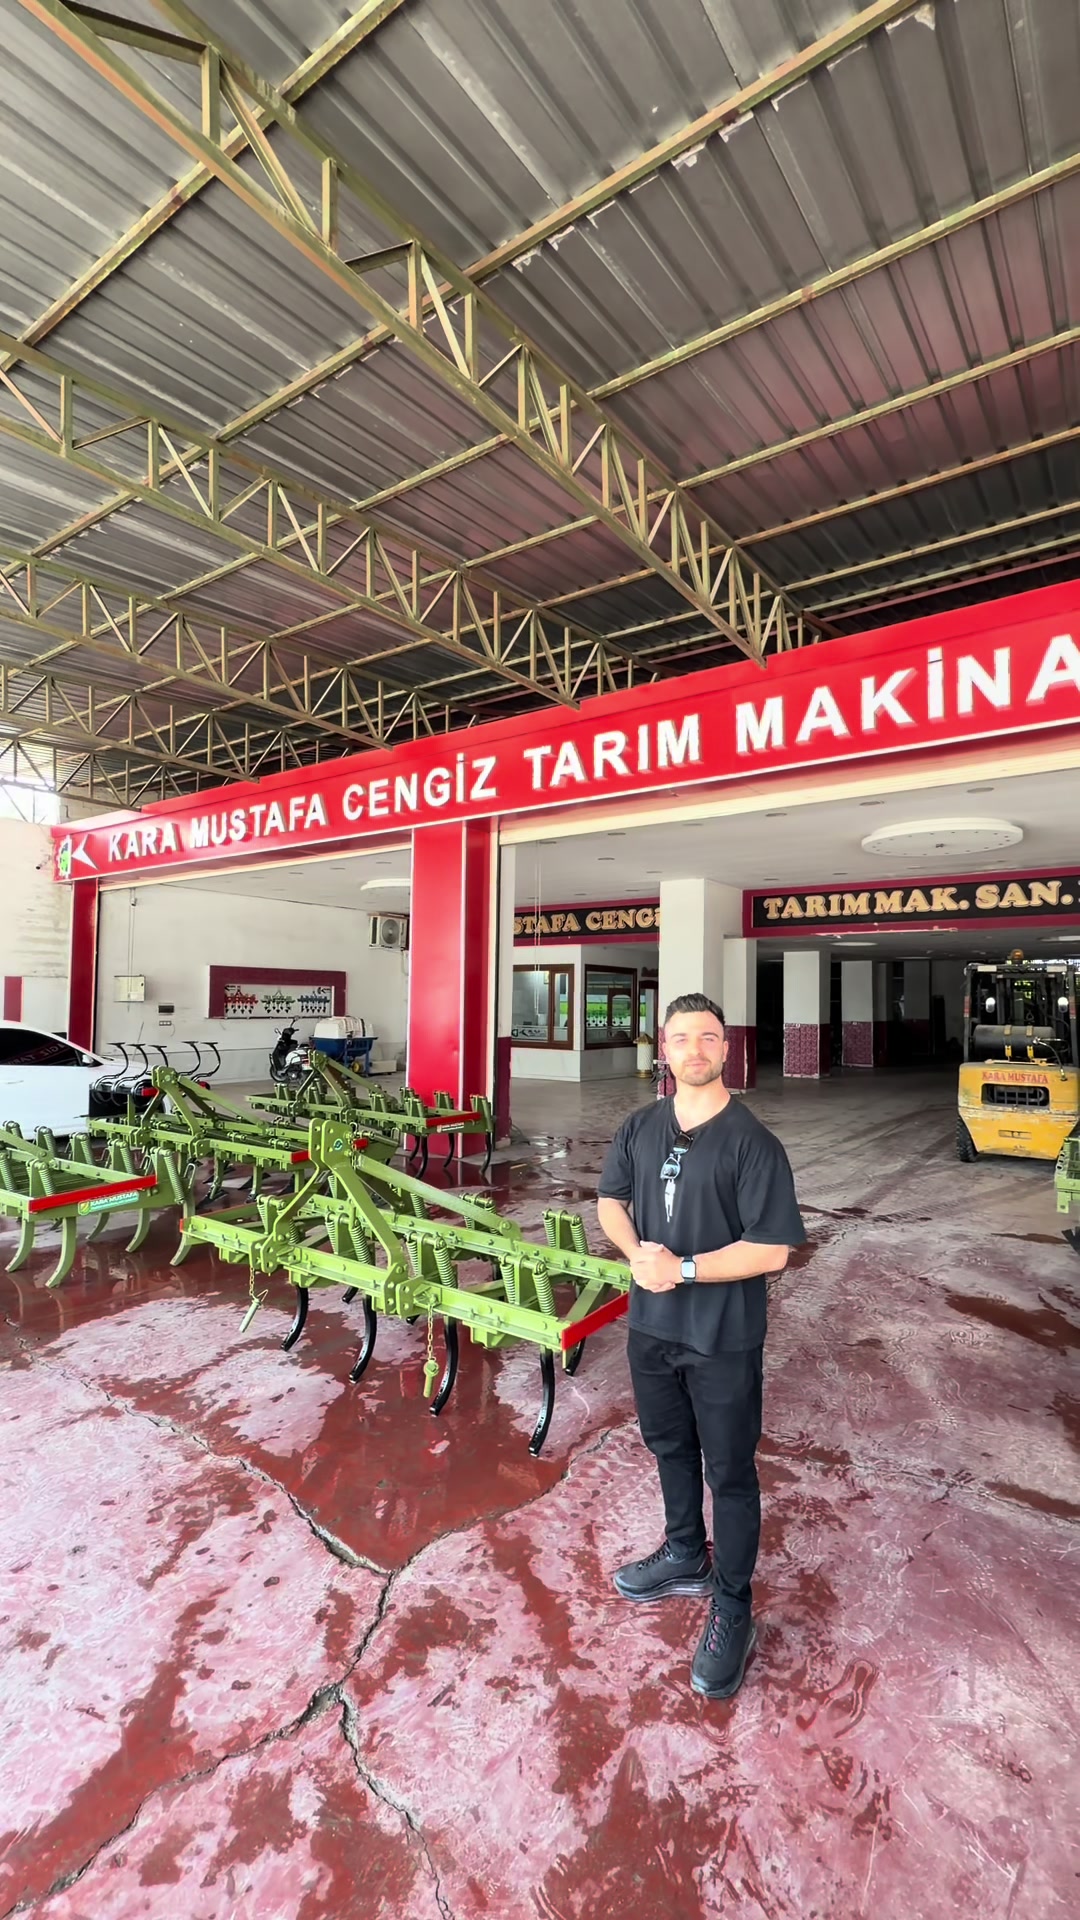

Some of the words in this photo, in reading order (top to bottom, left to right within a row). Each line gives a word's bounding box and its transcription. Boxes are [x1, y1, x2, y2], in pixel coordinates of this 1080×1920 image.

[108, 822, 179, 862] KARA
[189, 793, 328, 849] MUSTAFA
[342, 752, 497, 821] CENGİZ
[523, 713, 701, 791] TARIM
[734, 633, 1080, 754] MAKİNA
[763, 893, 871, 919] TARIM
[873, 886, 970, 914] MAK.
[975, 880, 1074, 910] SAN.
[982, 1071, 1006, 1081] KARA
[1008, 1073, 1049, 1085] MUSTAFA
